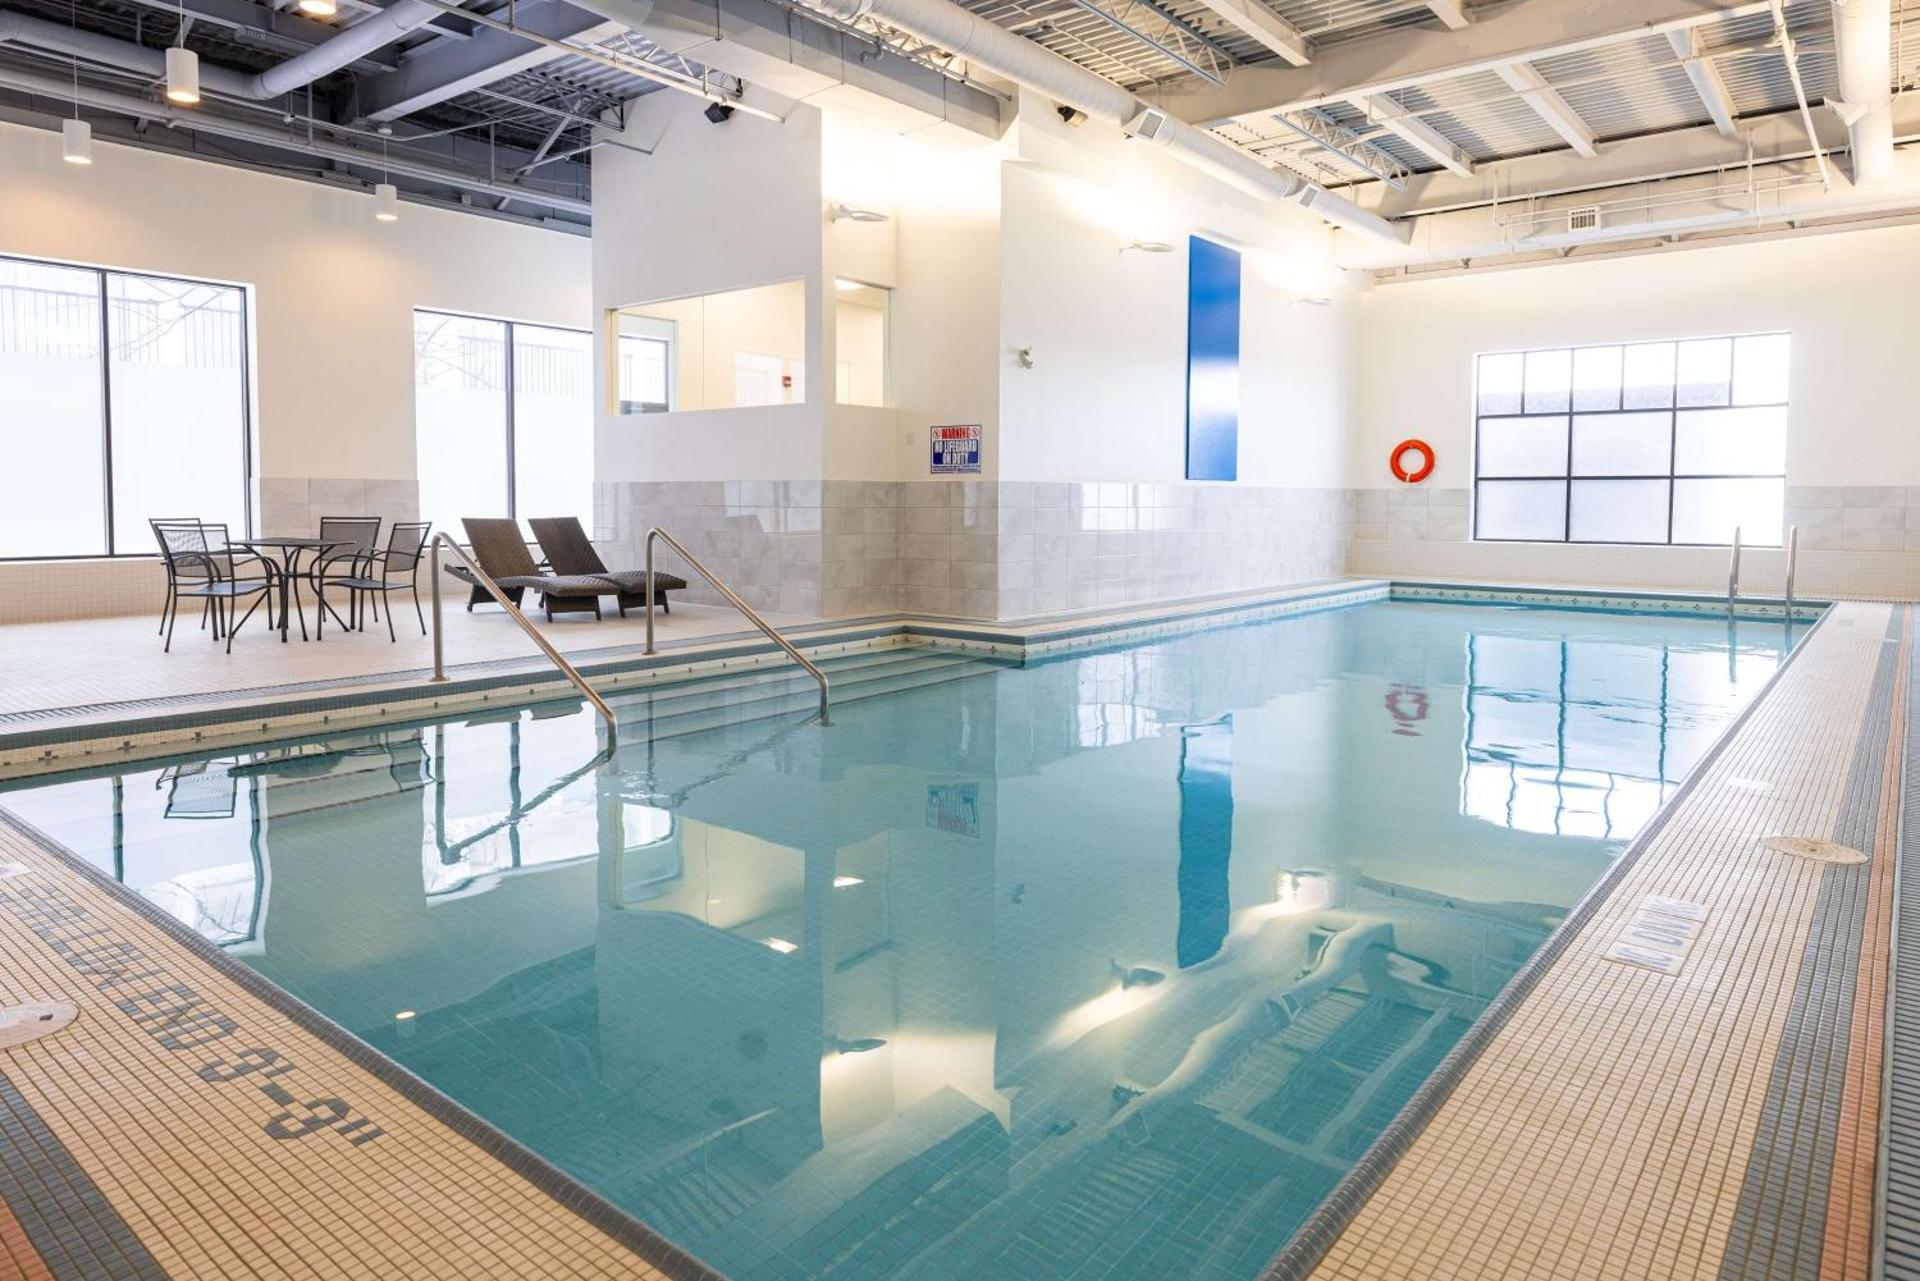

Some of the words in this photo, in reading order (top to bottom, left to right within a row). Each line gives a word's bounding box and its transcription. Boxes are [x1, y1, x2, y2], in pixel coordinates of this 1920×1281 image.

[942, 427, 970, 439] WARNING
[934, 440, 944, 453] NO
[944, 440, 977, 453] LIFEGUARD
[943, 452, 951, 464] ON
[952, 452, 968, 464] DUTY
[117, 984, 240, 1050] END
